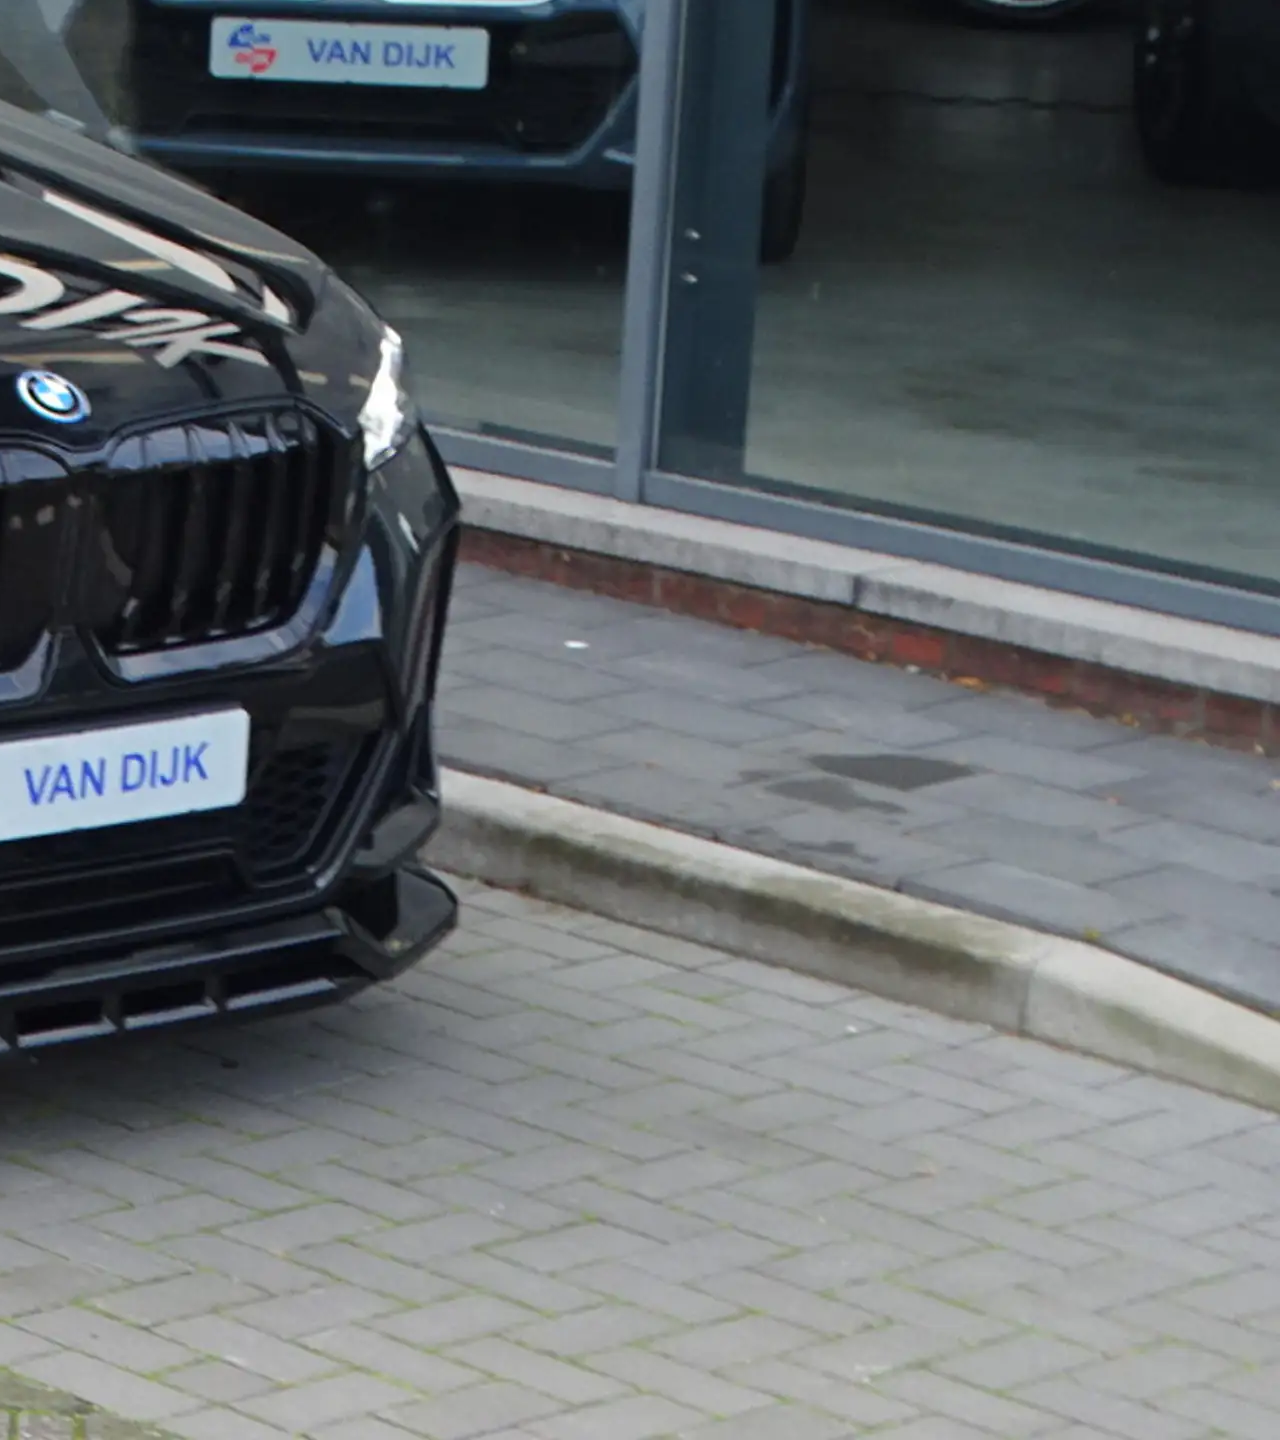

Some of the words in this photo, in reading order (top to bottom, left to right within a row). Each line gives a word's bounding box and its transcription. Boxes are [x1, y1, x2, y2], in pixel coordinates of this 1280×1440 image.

[306, 37, 371, 65] VAN
[381, 42, 456, 69] DIJK
[24, 758, 107, 806] VAN
[121, 742, 211, 794] DIJK
